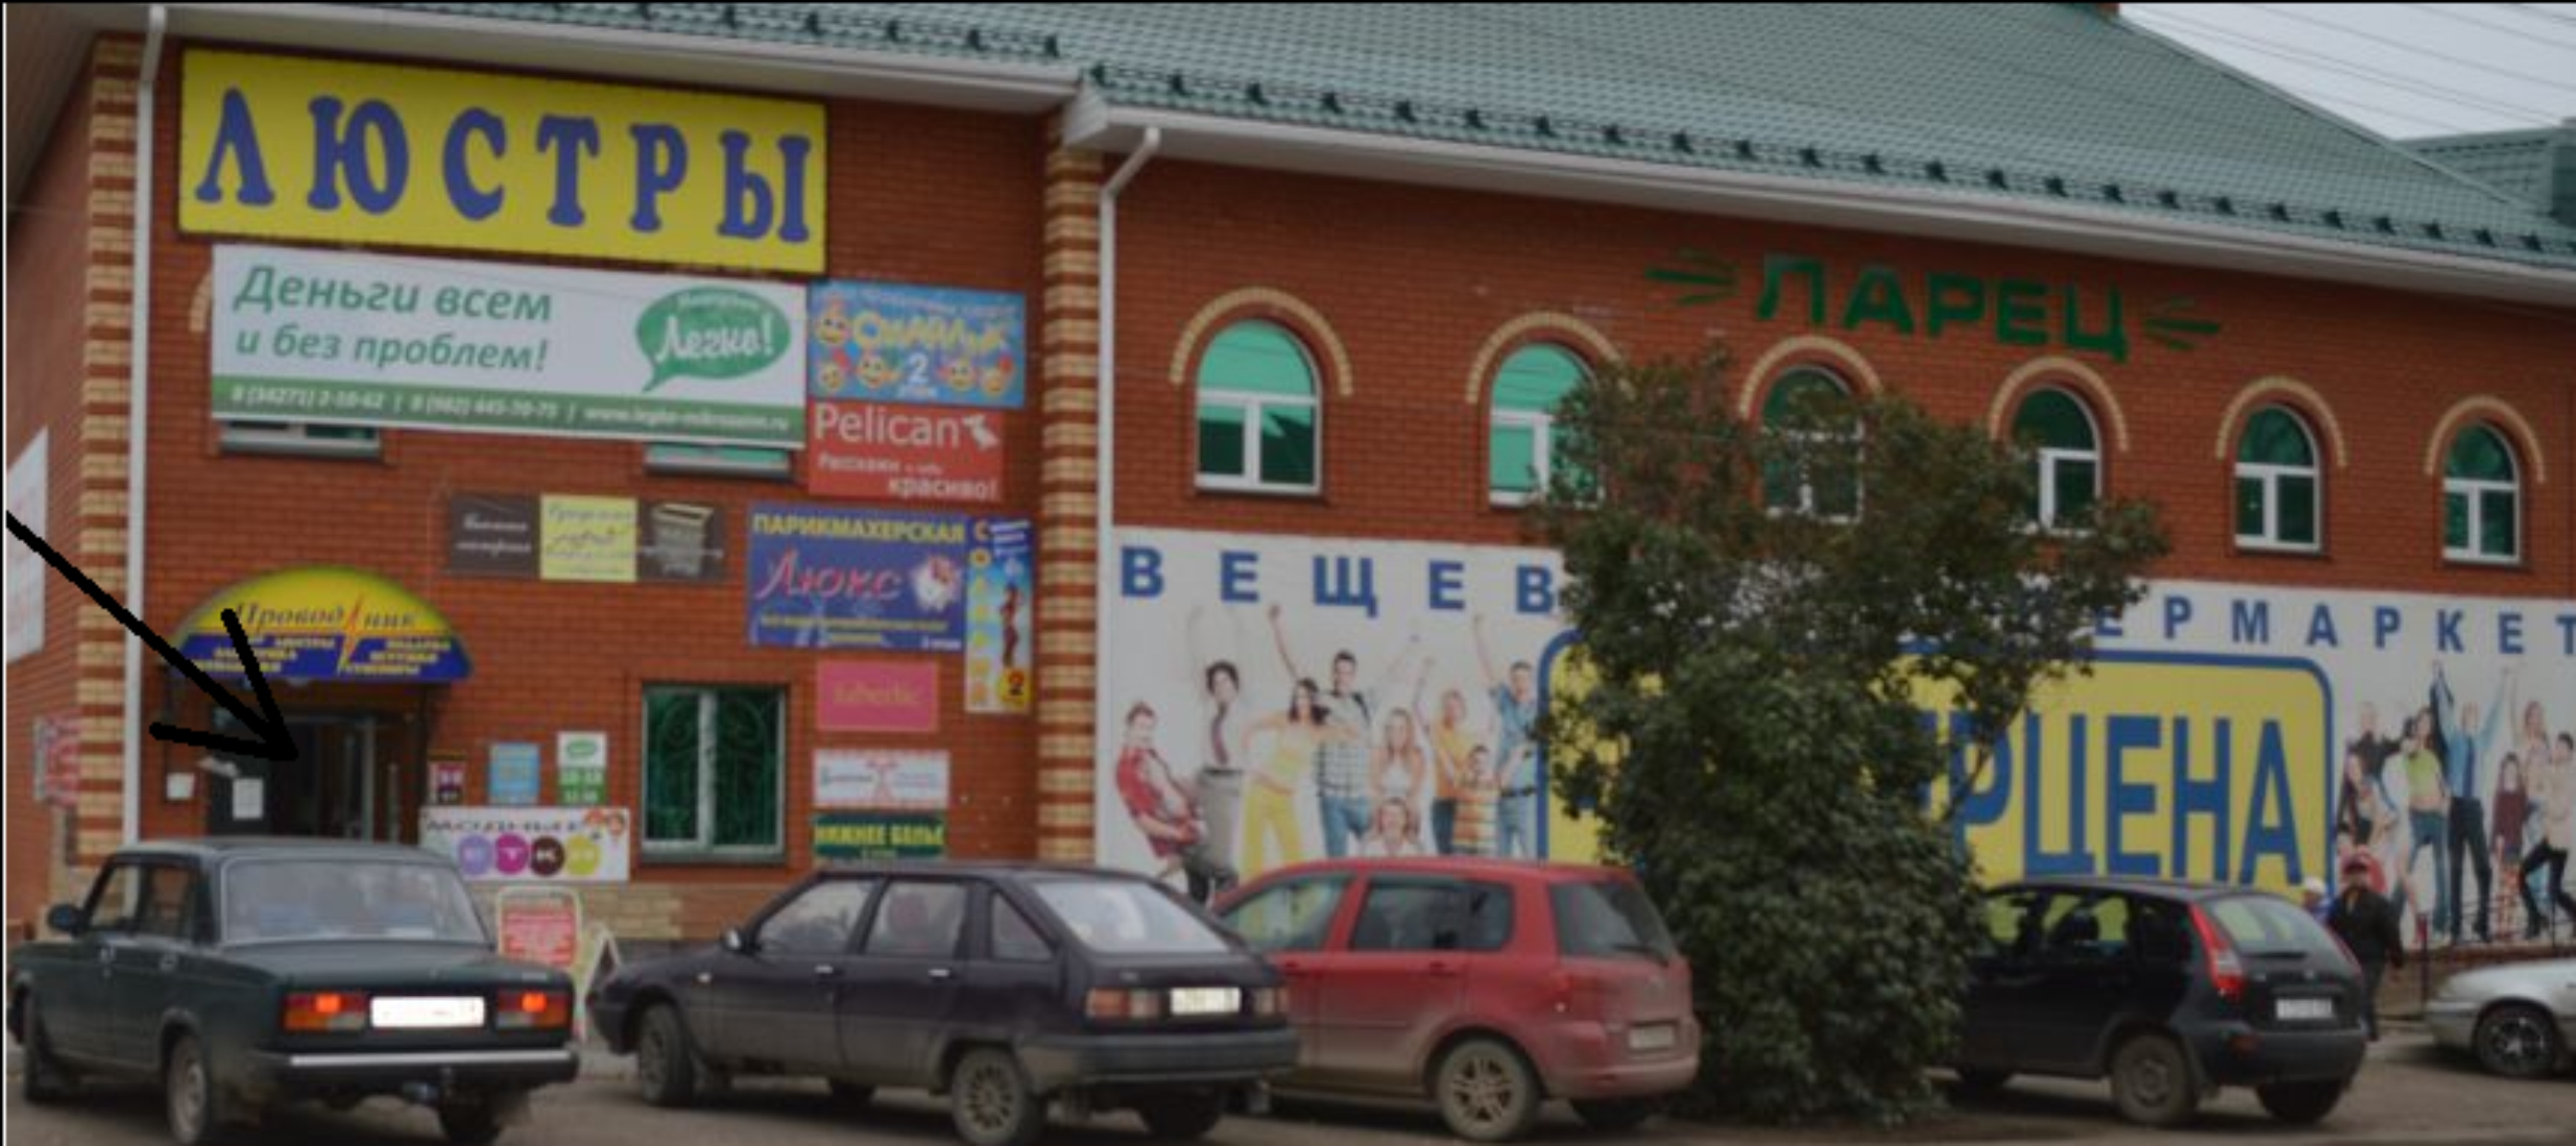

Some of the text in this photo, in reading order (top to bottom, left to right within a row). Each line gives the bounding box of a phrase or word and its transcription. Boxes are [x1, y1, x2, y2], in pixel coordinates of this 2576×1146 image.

[194, 87, 811, 243] ЛЮСТРЫ
[233, 265, 552, 322] Деньги всем
[235, 322, 547, 372] и без проблем!
[909, 352, 930, 383] 2
[814, 403, 960, 447] Pelican
[753, 512, 965, 544] ПАРИКМАХЕРСКАЯ
[754, 544, 904, 600] Люкс
[1121, 546, 1555, 617] ВЕЩЕВ
[1918, 709, 2304, 885] РЦЕНА
